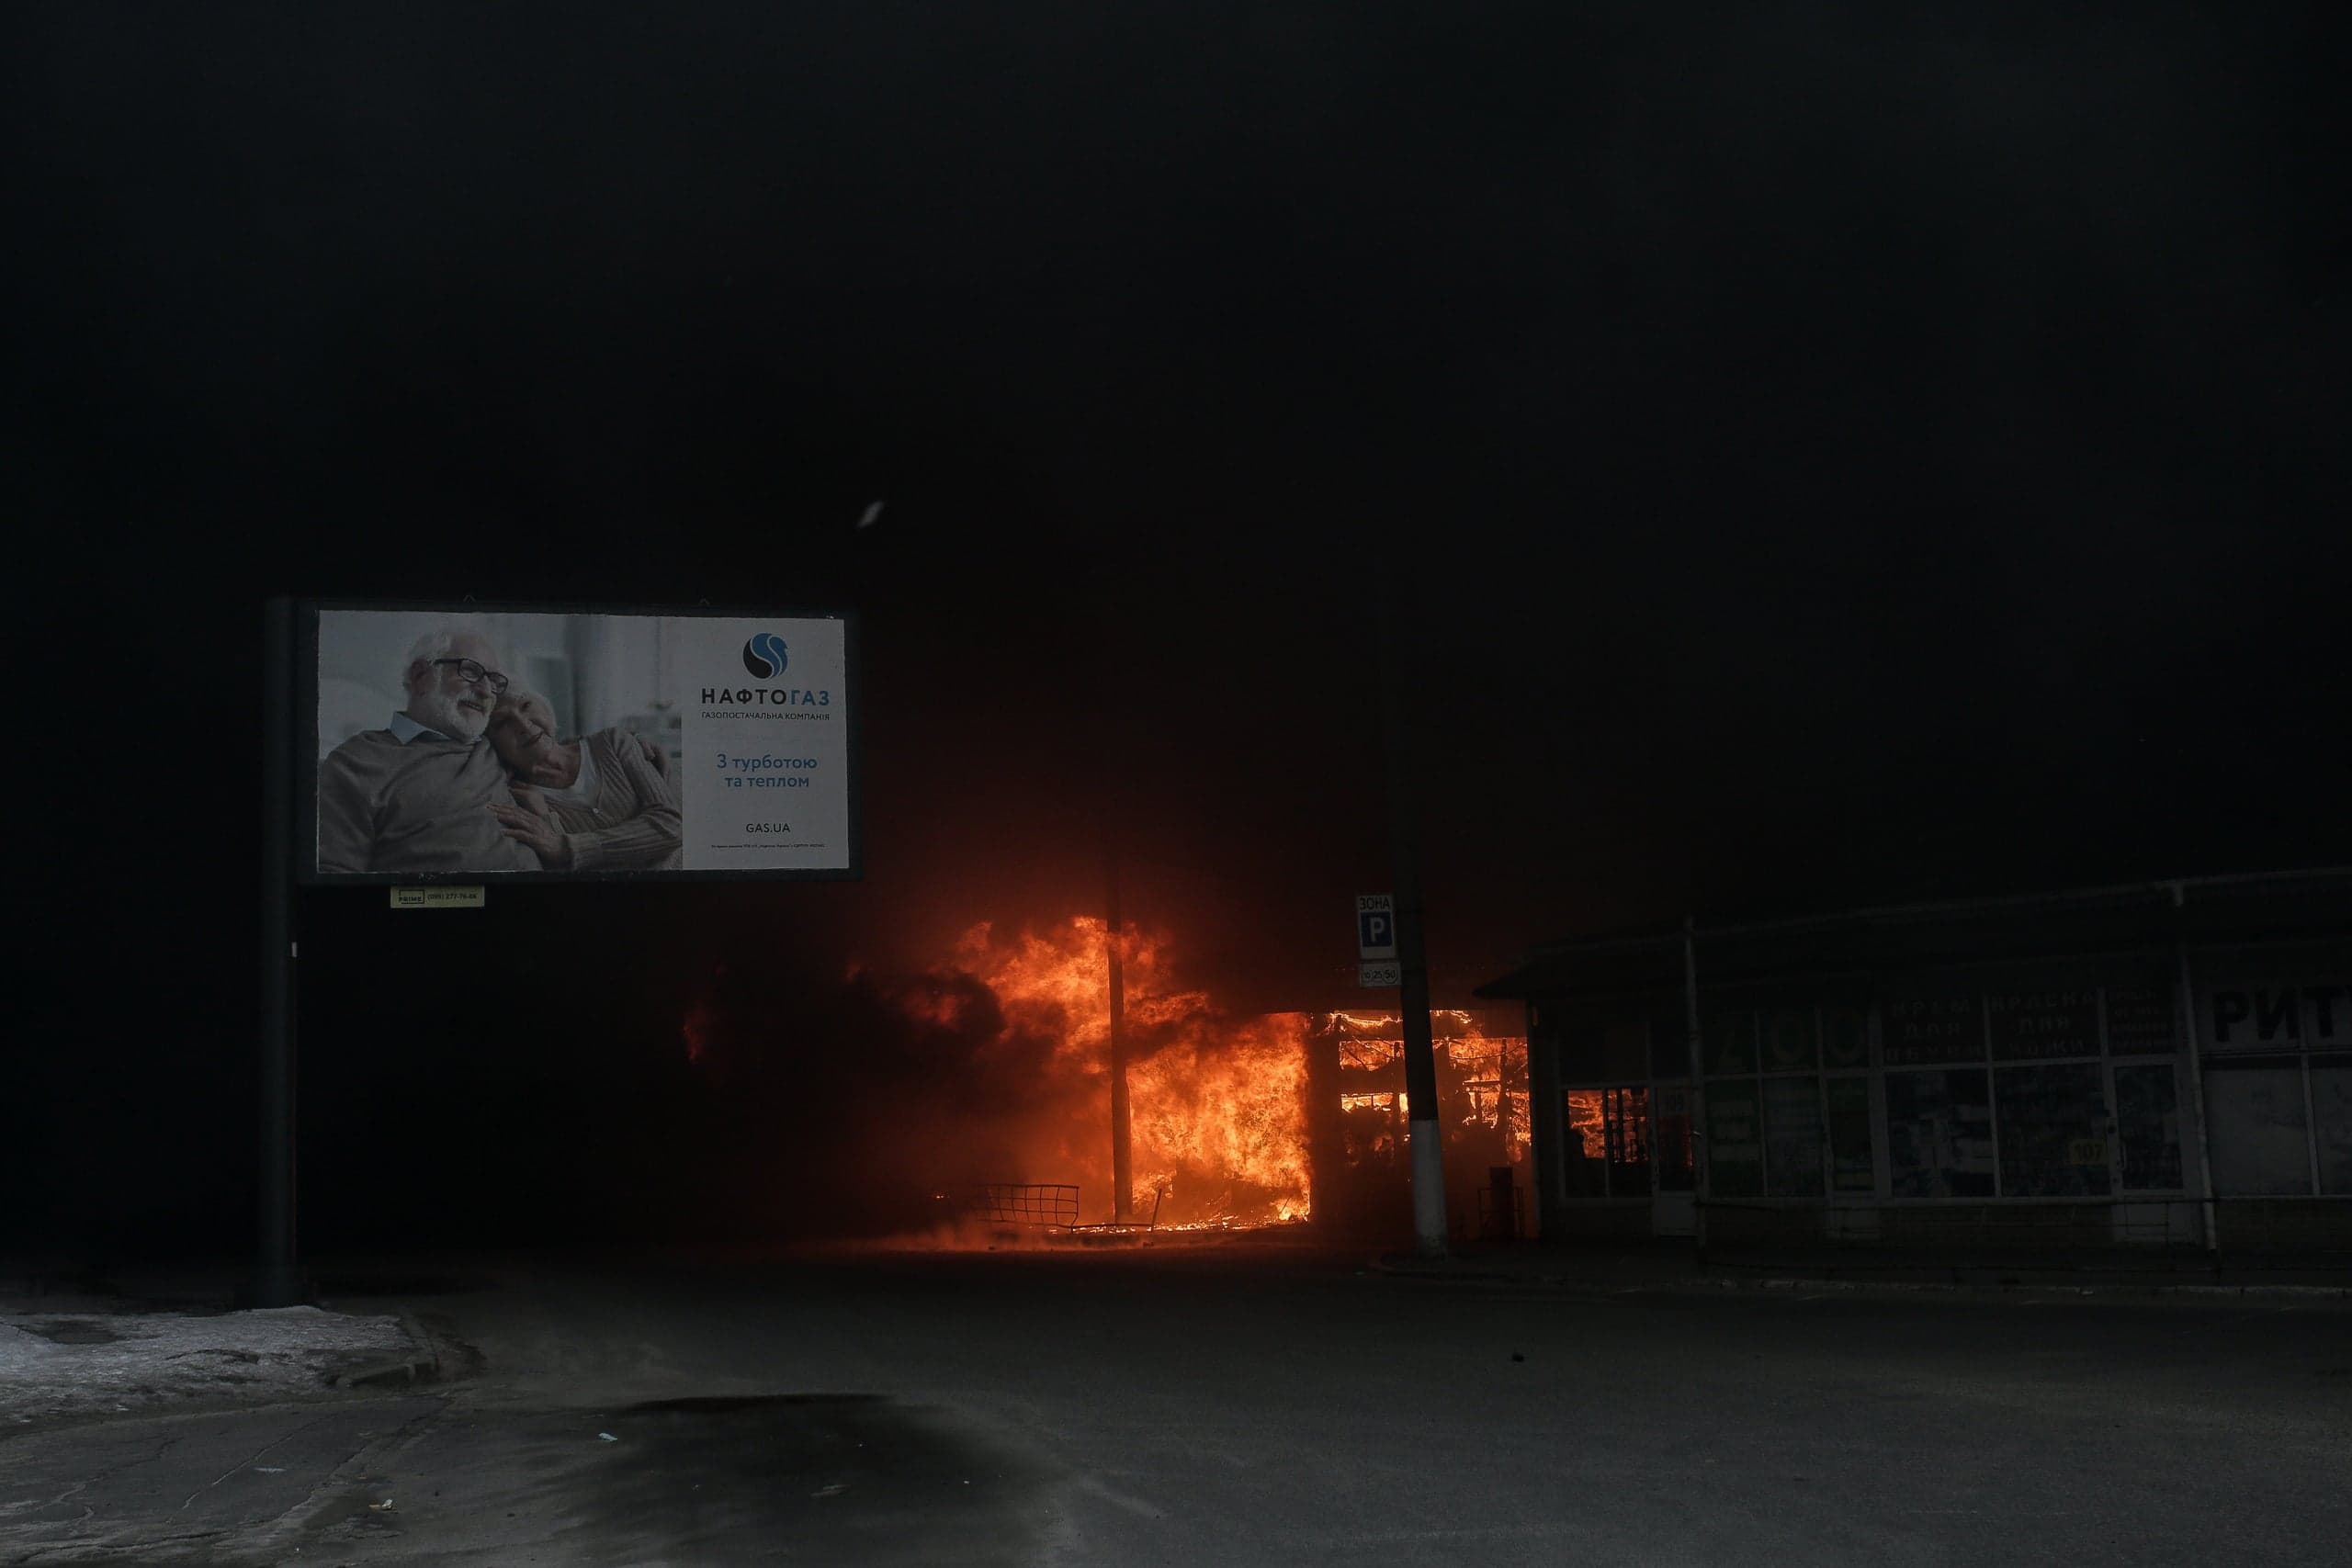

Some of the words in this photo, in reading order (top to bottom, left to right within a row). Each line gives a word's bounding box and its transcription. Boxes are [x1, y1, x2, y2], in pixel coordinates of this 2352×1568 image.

[701, 688, 830, 705] НАФТОГАЗ
[701, 711, 784, 720] ГАЗОПОСТАЧАЛЬНА
[785, 712, 830, 721] КОМПАНІЯ
[717, 753, 727, 769] З
[732, 754, 818, 773] турботою
[725, 776, 742, 787] та
[746, 776, 809, 787] теплом
[746, 823, 791, 833] GAS.UA
[1360, 897, 1390, 910] ЗОНА
[1369, 917, 1385, 942] P
[2212, 985, 2352, 1043] РИТ
